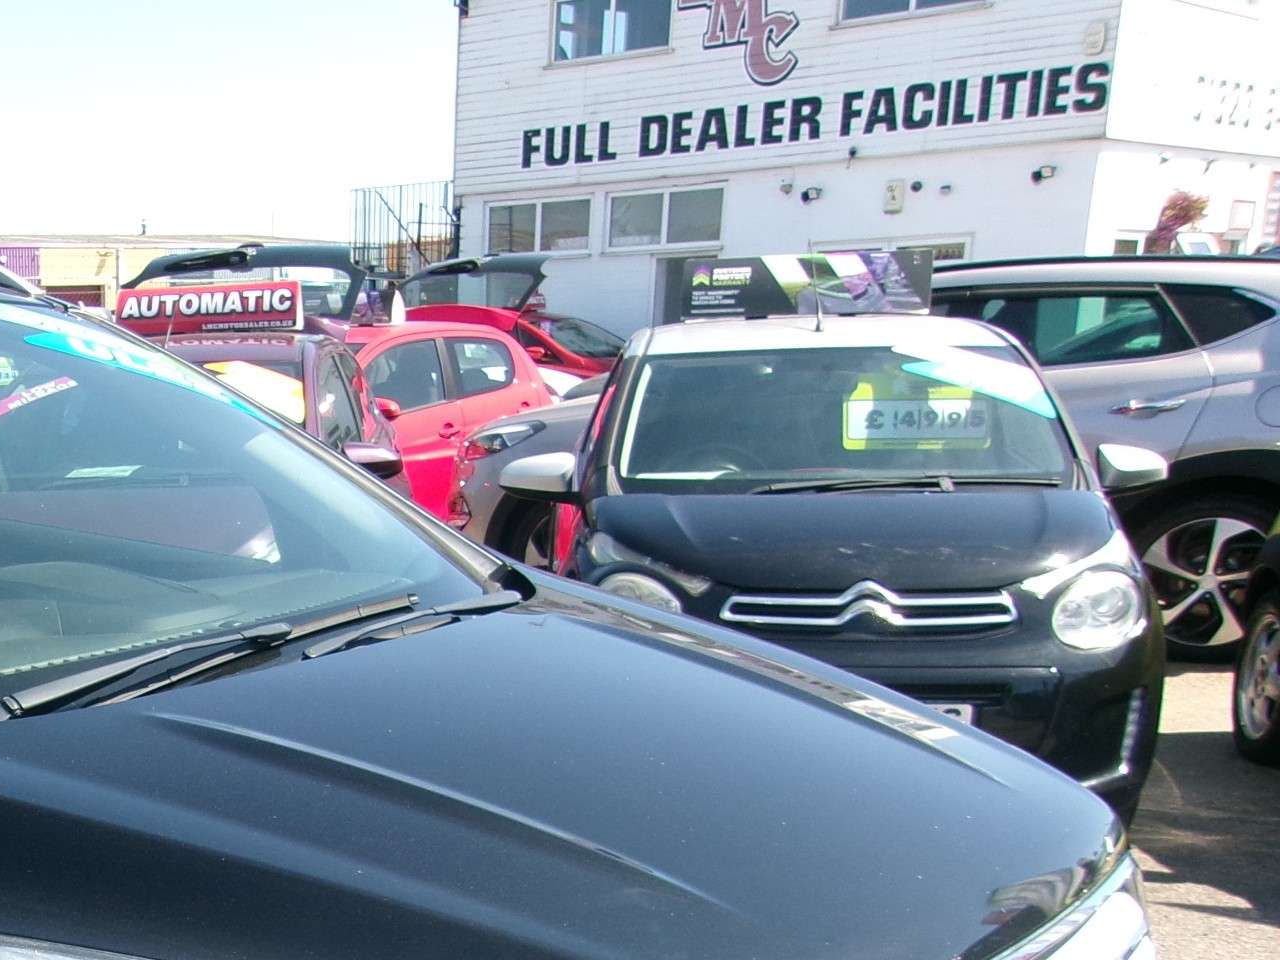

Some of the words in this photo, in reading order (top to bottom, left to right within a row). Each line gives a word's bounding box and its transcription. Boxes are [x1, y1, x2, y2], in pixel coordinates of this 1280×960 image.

[521, 120, 617, 169] FULL
[639, 95, 824, 160] DEALER
[839, 62, 1111, 138] FACILITIES
[121, 287, 294, 320] AUTOMATIC
